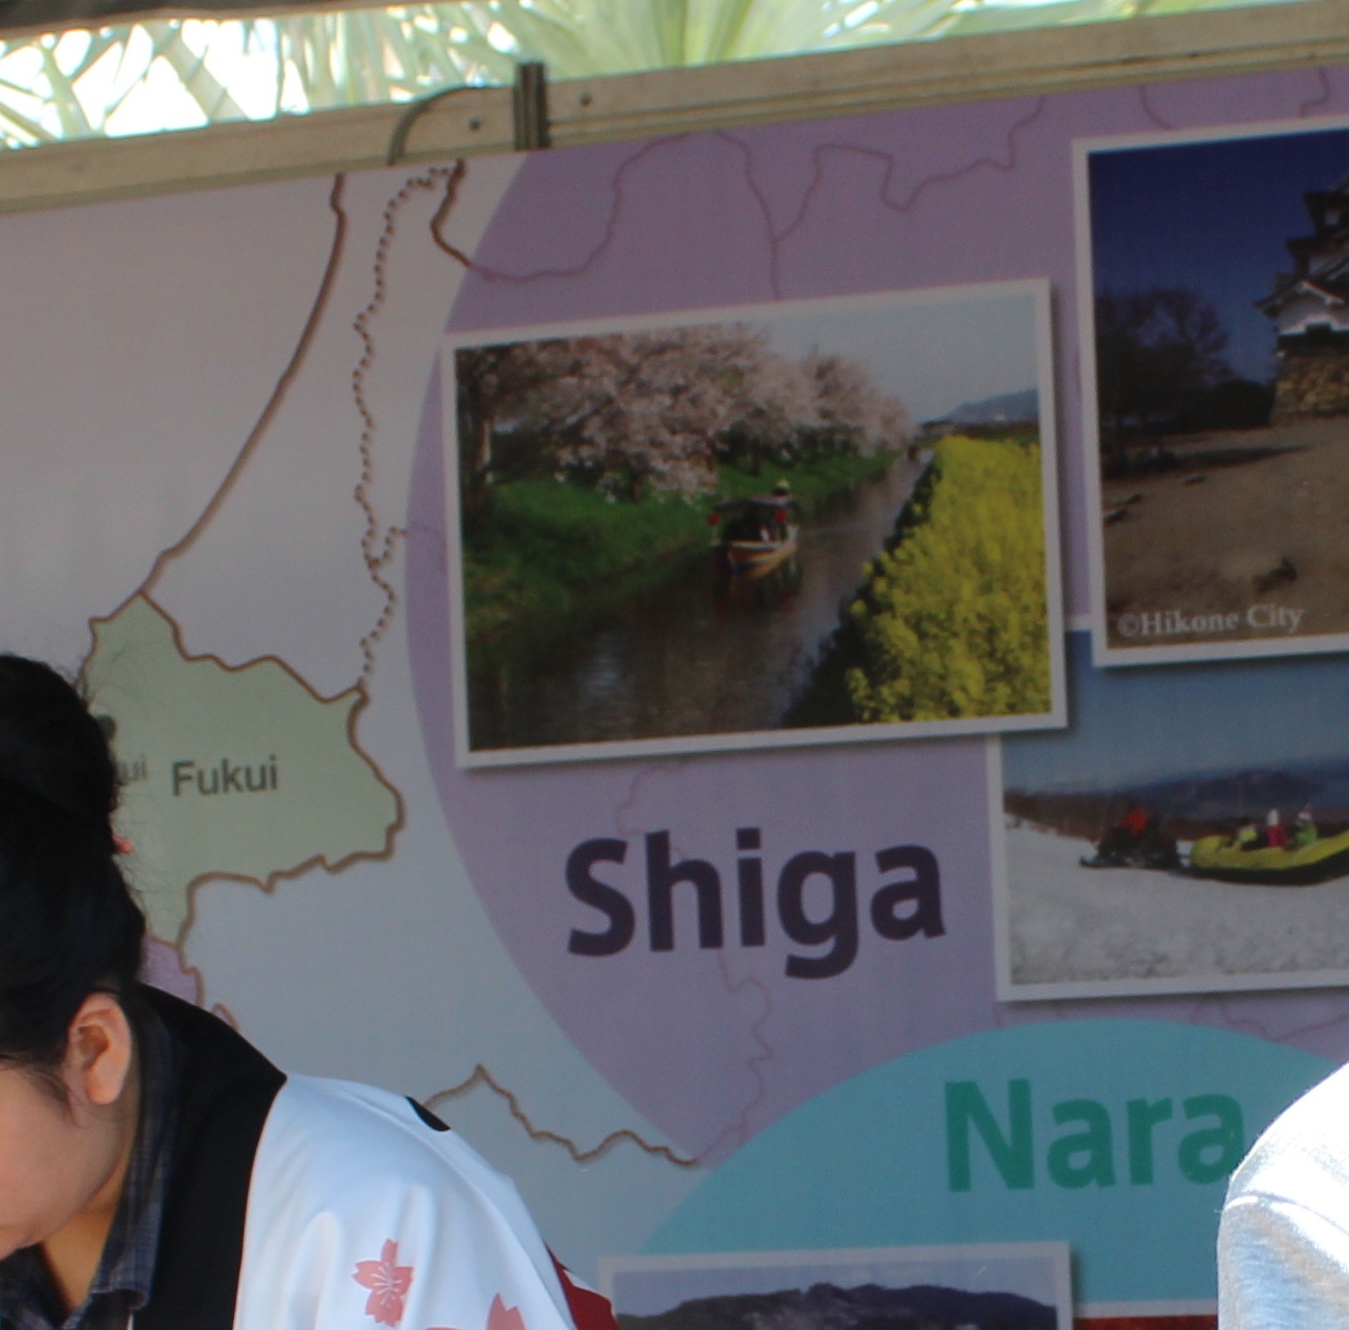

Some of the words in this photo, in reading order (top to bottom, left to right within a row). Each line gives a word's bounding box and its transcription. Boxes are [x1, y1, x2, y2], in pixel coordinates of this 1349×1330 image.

[1247, 604, 1304, 634] City
[172, 753, 278, 797] Fukui
[565, 827, 947, 980] Shiga
[945, 1078, 1245, 1193] Nara
